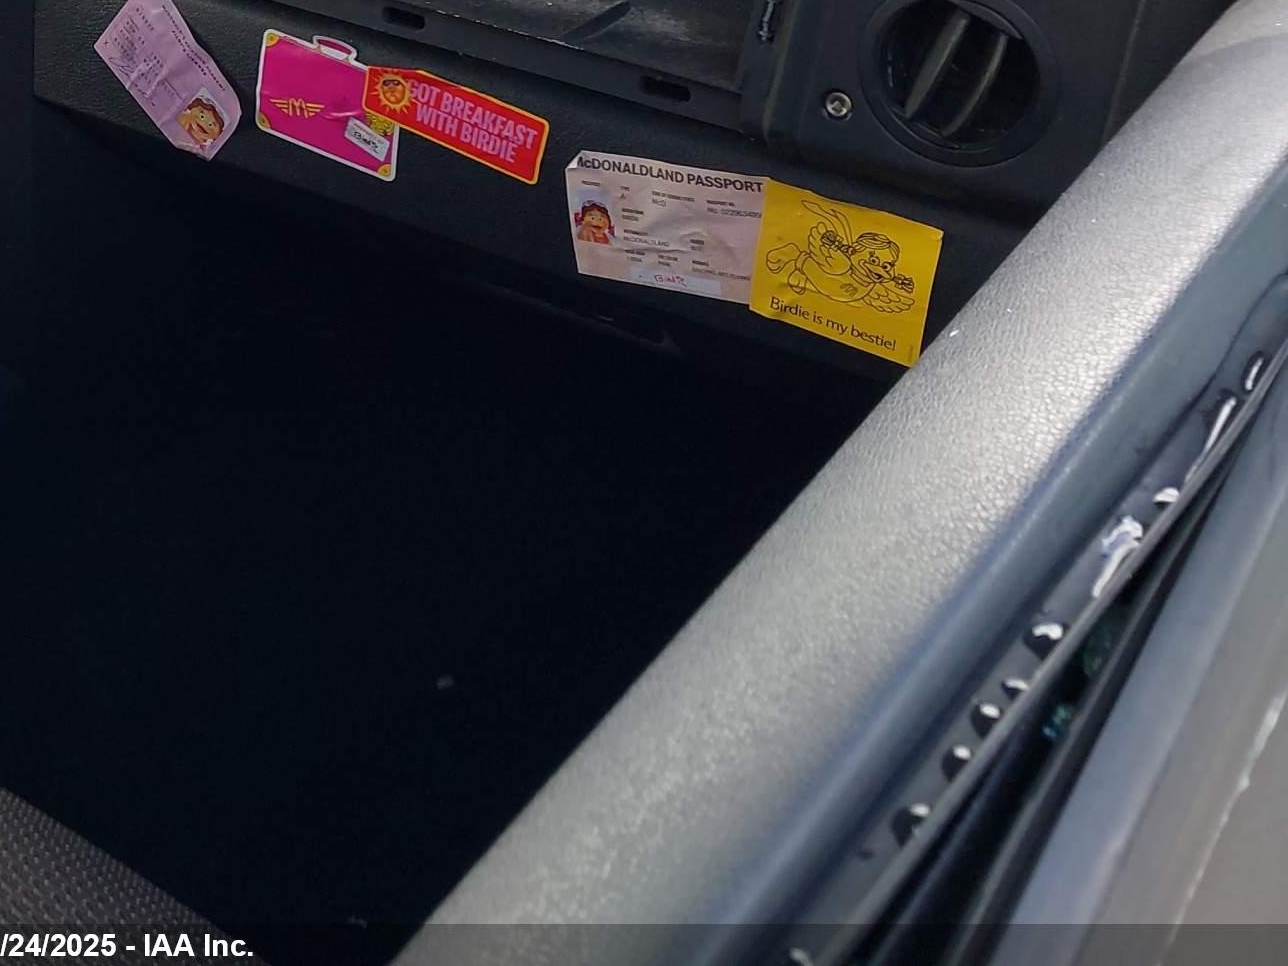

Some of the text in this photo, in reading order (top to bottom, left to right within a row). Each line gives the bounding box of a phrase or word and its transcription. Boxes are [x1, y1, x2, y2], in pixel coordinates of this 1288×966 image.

[407, 78, 538, 149] GOT BREAKFAST
[416, 103, 459, 137] WITH
[460, 123, 519, 163] BIRDIE
[687, 173, 764, 193] PASSPORT
[770, 296, 897, 351] Birdie is my bestie!
